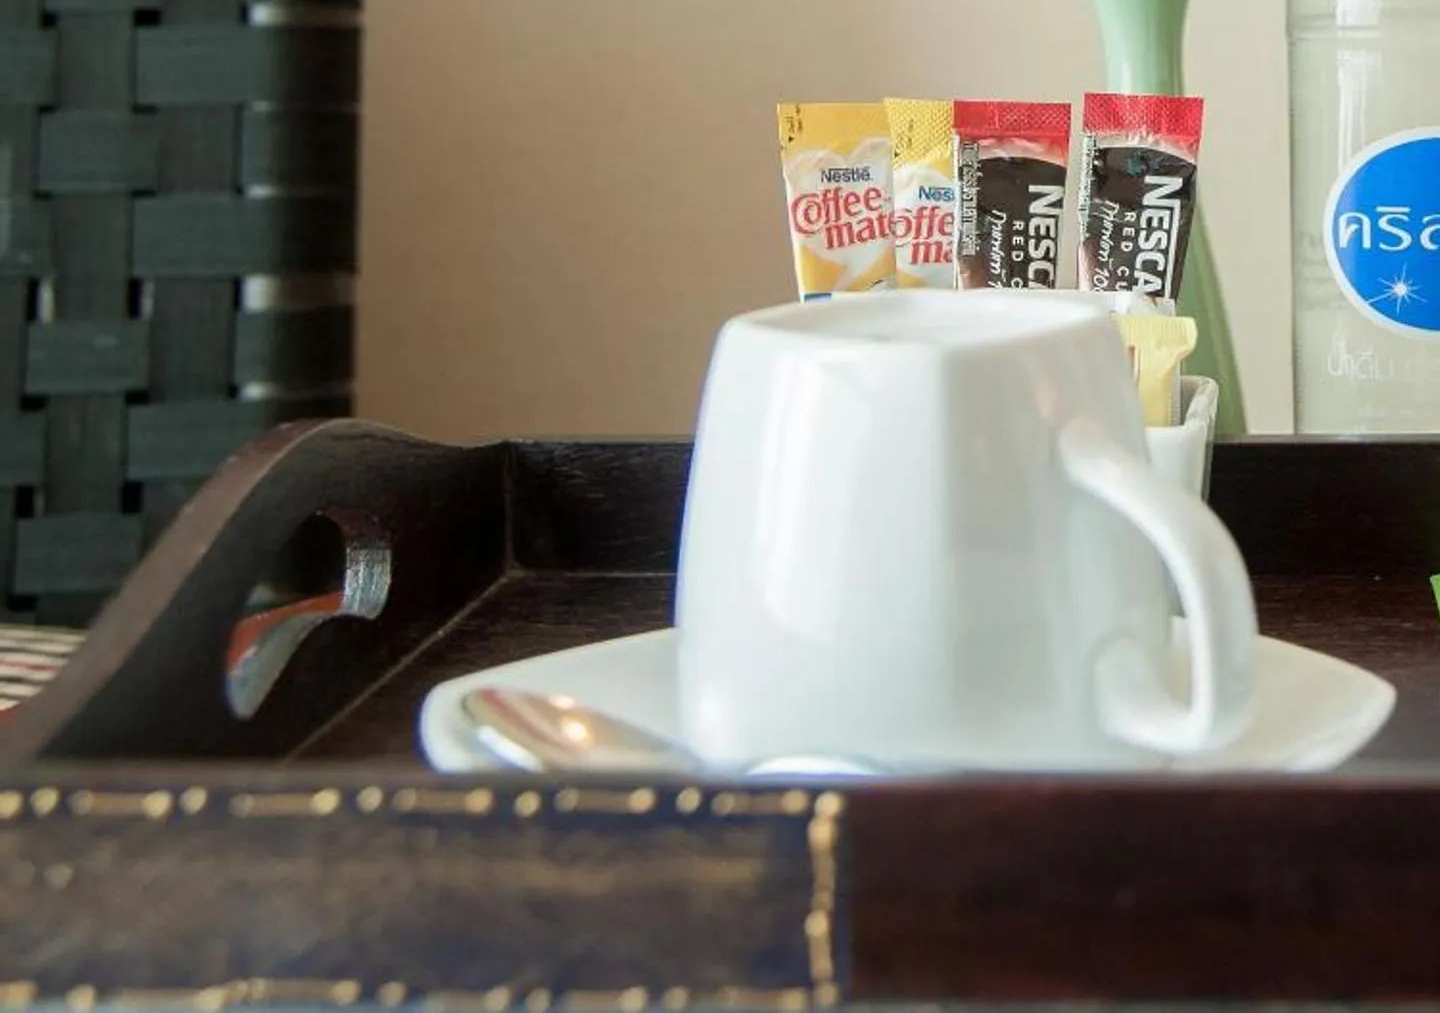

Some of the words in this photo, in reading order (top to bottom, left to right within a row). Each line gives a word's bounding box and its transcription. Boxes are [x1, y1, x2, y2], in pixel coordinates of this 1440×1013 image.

[791, 186, 883, 235] Coffee
[918, 185, 955, 202] Nes
[895, 204, 954, 246] offe
[1011, 219, 1025, 262] RED
[1121, 211, 1138, 253] RED
[1132, 174, 1184, 298] NESCA
[1115, 265, 1130, 292] CU
